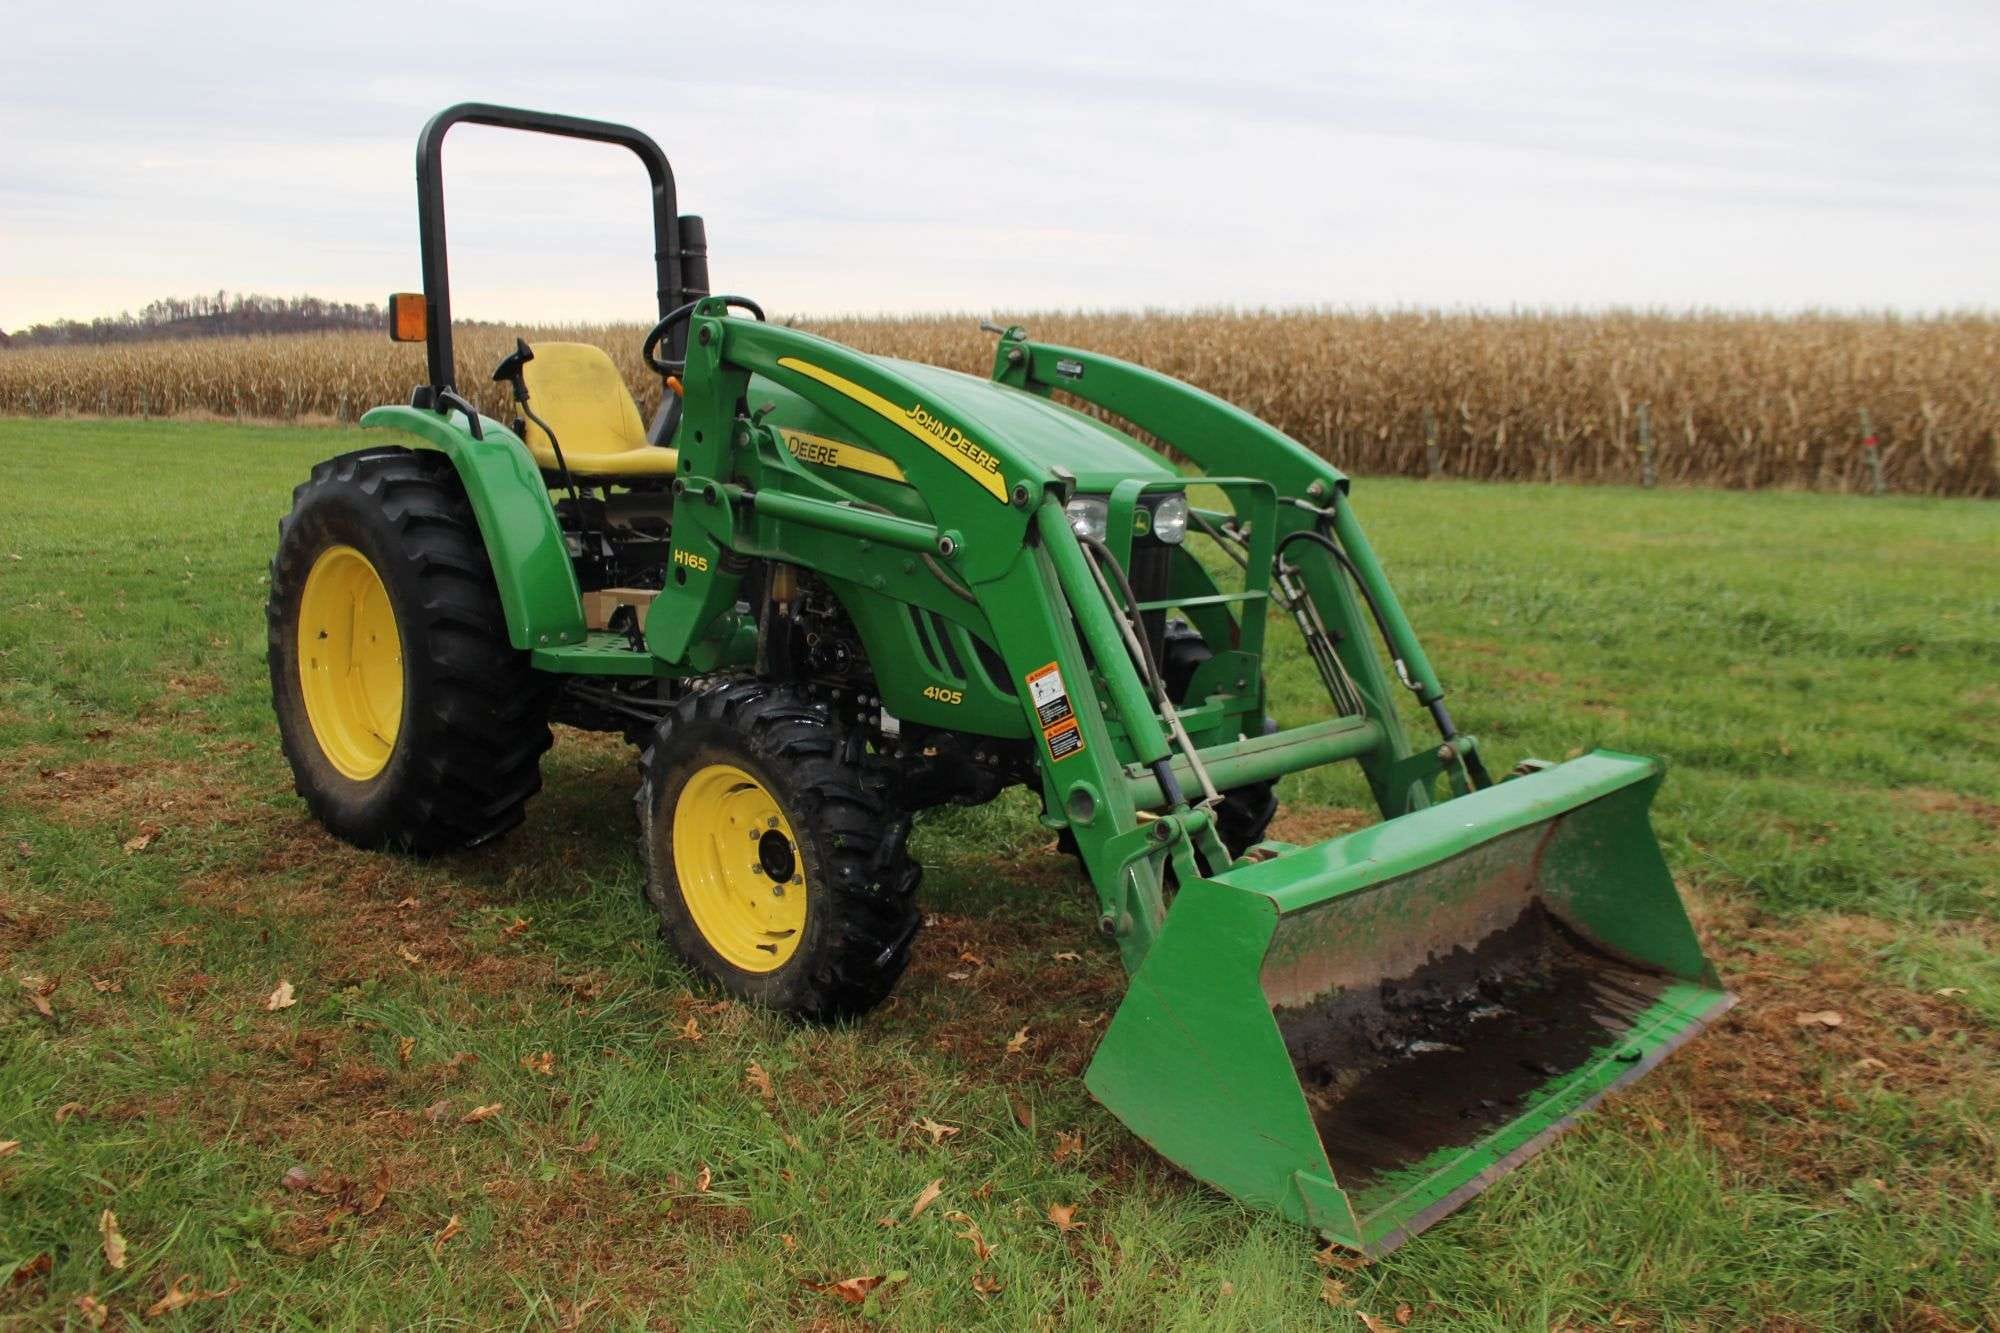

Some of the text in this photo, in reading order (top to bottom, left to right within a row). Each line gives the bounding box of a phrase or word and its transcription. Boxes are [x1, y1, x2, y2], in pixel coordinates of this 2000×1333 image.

[788, 436, 838, 465] DEERE
[906, 404, 1001, 475] JOHN DEERE
[674, 549, 708, 571] H165
[923, 686, 963, 705] 4105
